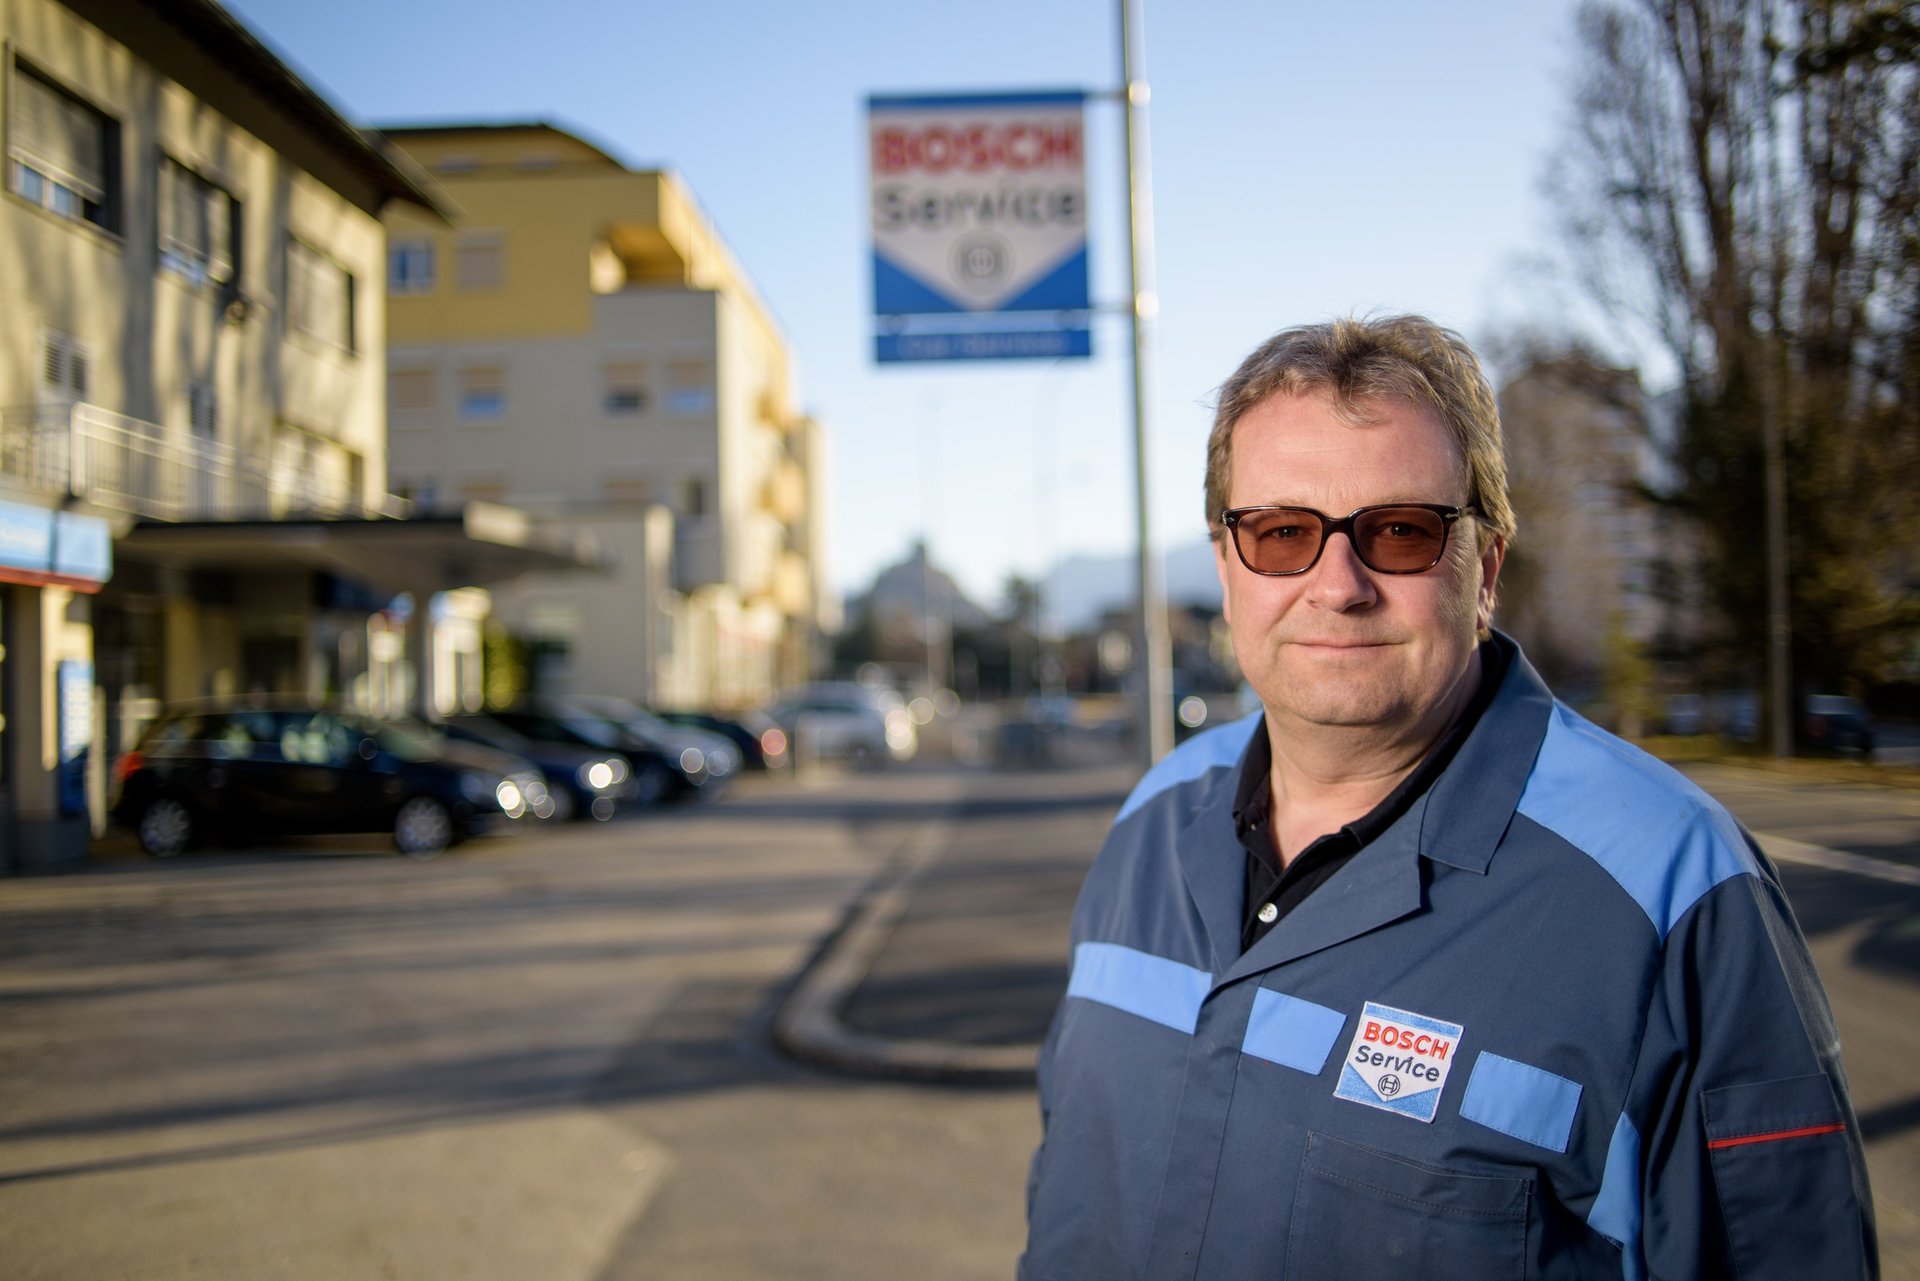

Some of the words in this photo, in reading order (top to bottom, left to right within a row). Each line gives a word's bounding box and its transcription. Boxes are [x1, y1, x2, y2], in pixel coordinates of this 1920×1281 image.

[873, 124, 1080, 173] BOSCH
[874, 181, 1083, 230] Service
[1363, 1021, 1449, 1060] BOSCH
[1355, 1045, 1440, 1082] Service
